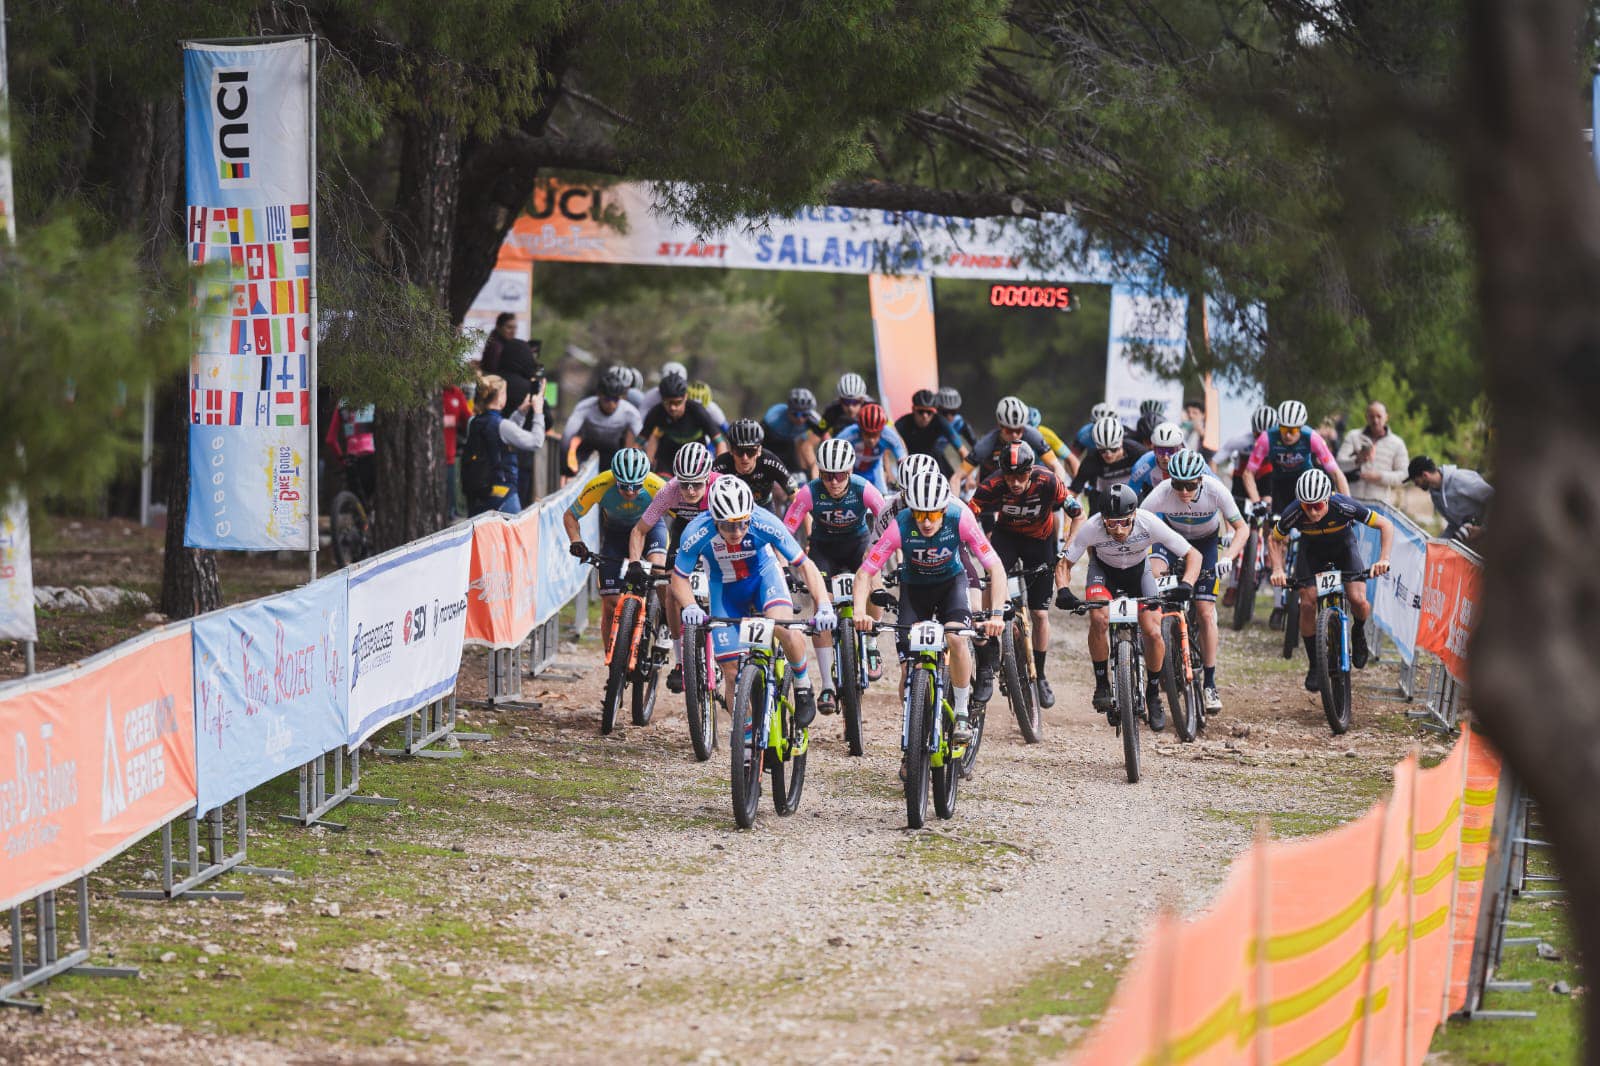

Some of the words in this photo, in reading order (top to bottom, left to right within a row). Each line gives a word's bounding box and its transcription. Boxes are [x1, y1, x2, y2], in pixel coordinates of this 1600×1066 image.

[657, 242, 729, 259] START
[912, 546, 953, 561] TSA
[837, 578, 853, 597] 18
[1321, 575, 1336, 589] 42
[1118, 600, 1128, 616] 4
[747, 623, 765, 643] 12
[919, 625, 936, 645] 15
[126, 742, 166, 806] SERIES
